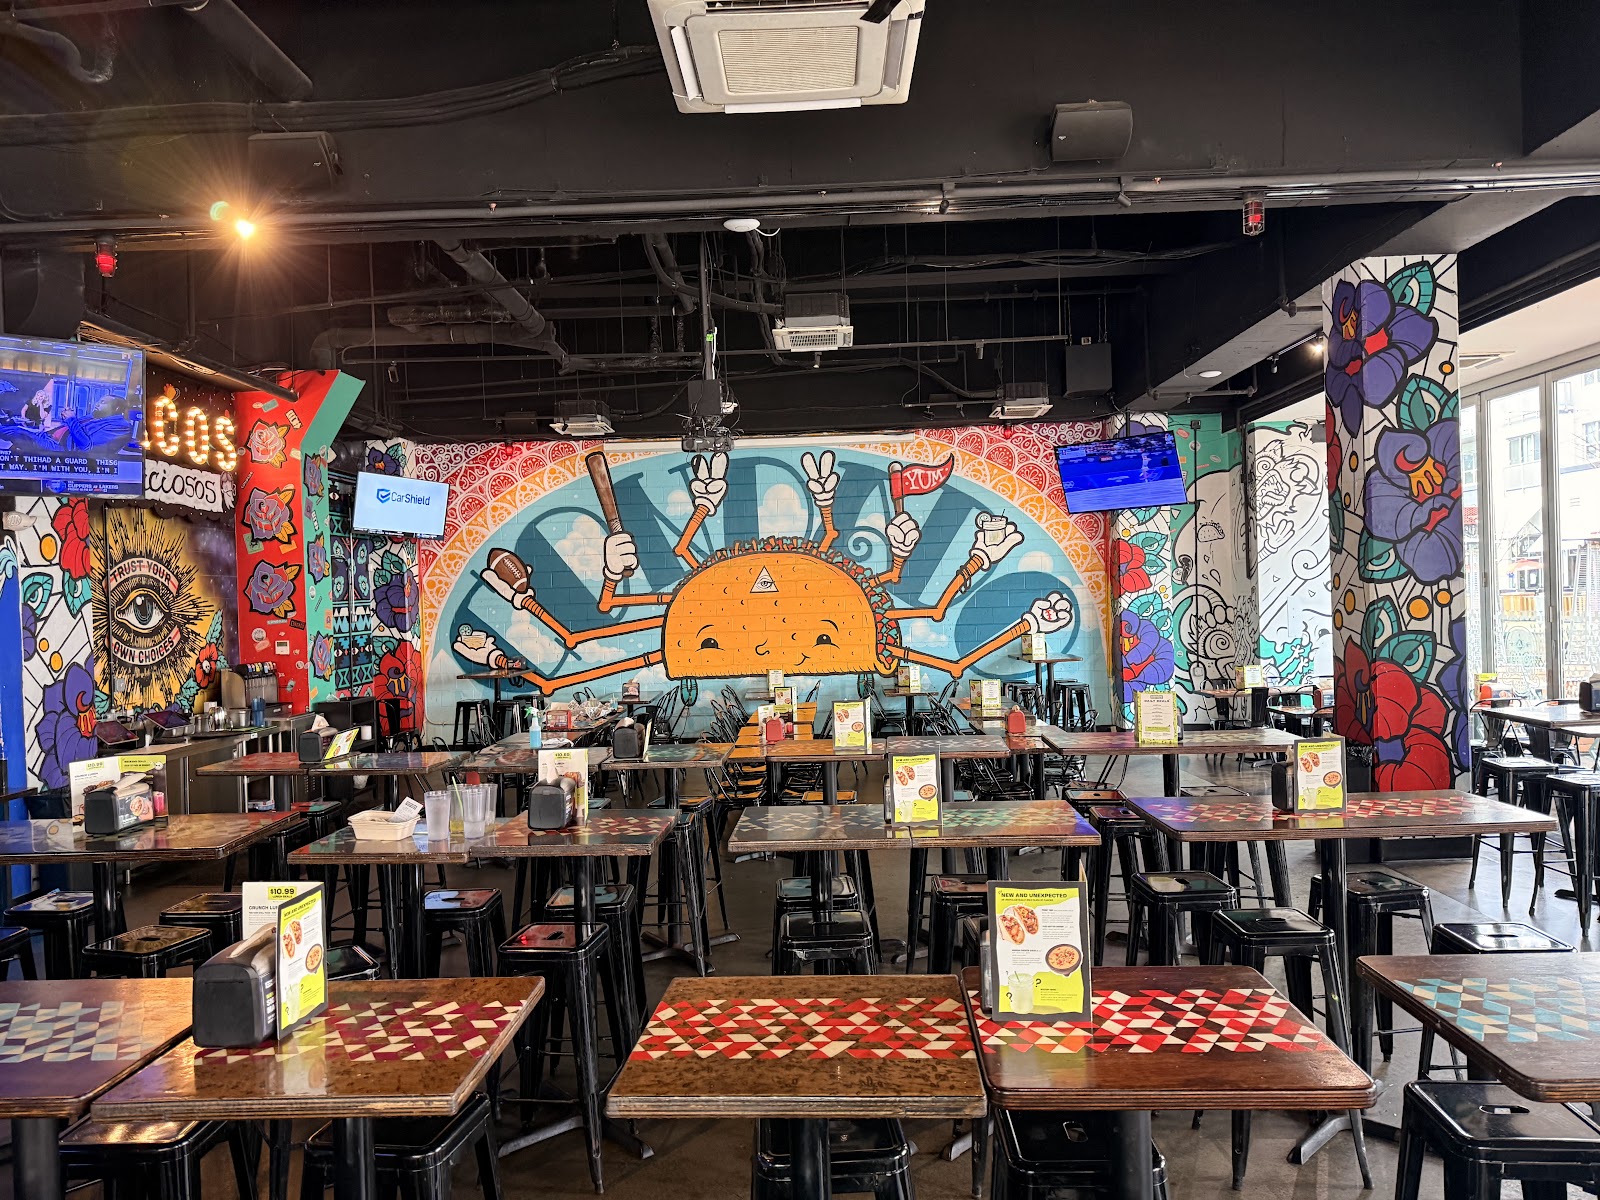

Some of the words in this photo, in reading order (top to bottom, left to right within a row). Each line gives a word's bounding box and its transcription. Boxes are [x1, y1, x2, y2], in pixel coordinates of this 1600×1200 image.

[143, 396, 238, 472] COS
[9, 463, 28, 471] WAY.
[33, 464, 48, 472] I'M
[74, 466, 91, 474] YOU,
[65, 457, 88, 465] GUARD
[903, 467, 944, 489] YUM
[391, 491, 431, 505] CarShield
[110, 560, 143, 583] TRUST
[146, 561, 171, 587] YOUR
[113, 641, 136, 662] OWN
[138, 636, 175, 664] CHOICES
